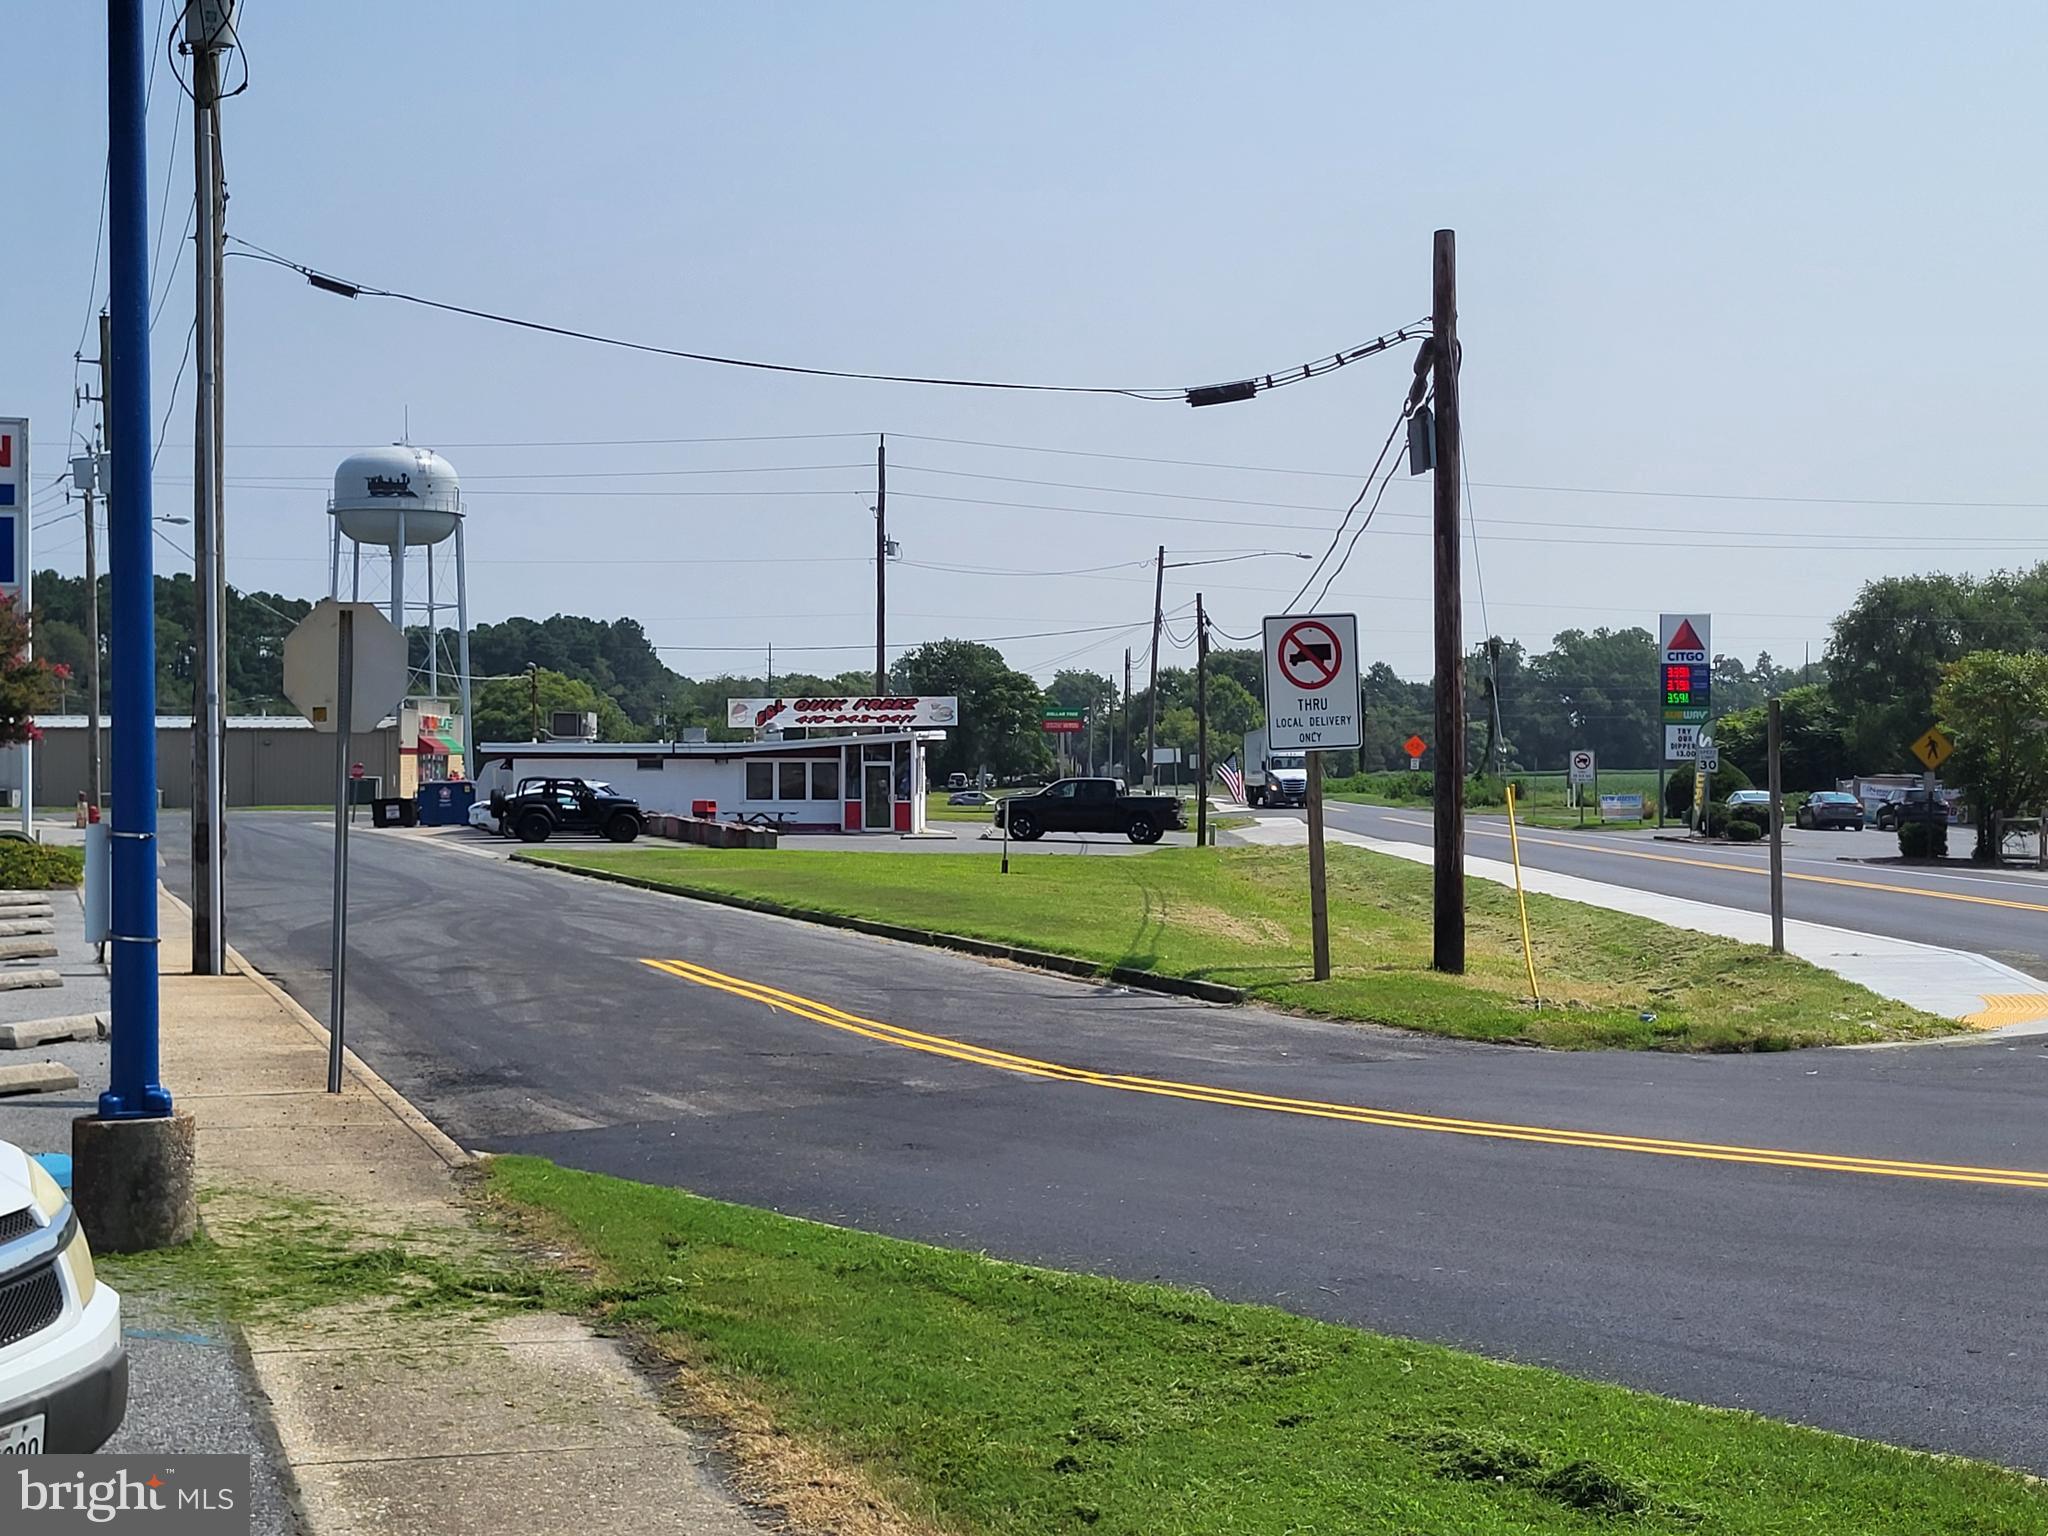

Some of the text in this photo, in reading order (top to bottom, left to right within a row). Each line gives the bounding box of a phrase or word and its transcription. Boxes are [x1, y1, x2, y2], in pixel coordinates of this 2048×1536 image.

[1667, 651, 1705, 661] CITGO
[793, 699, 848, 712] QUIK
[853, 698, 919, 711] FREEZ
[1297, 698, 1328, 711] THRU
[1276, 715, 1352, 728] LOCAL DELIVERY
[1299, 732, 1322, 743] ONLY
[1700, 760, 1717, 770] 30
